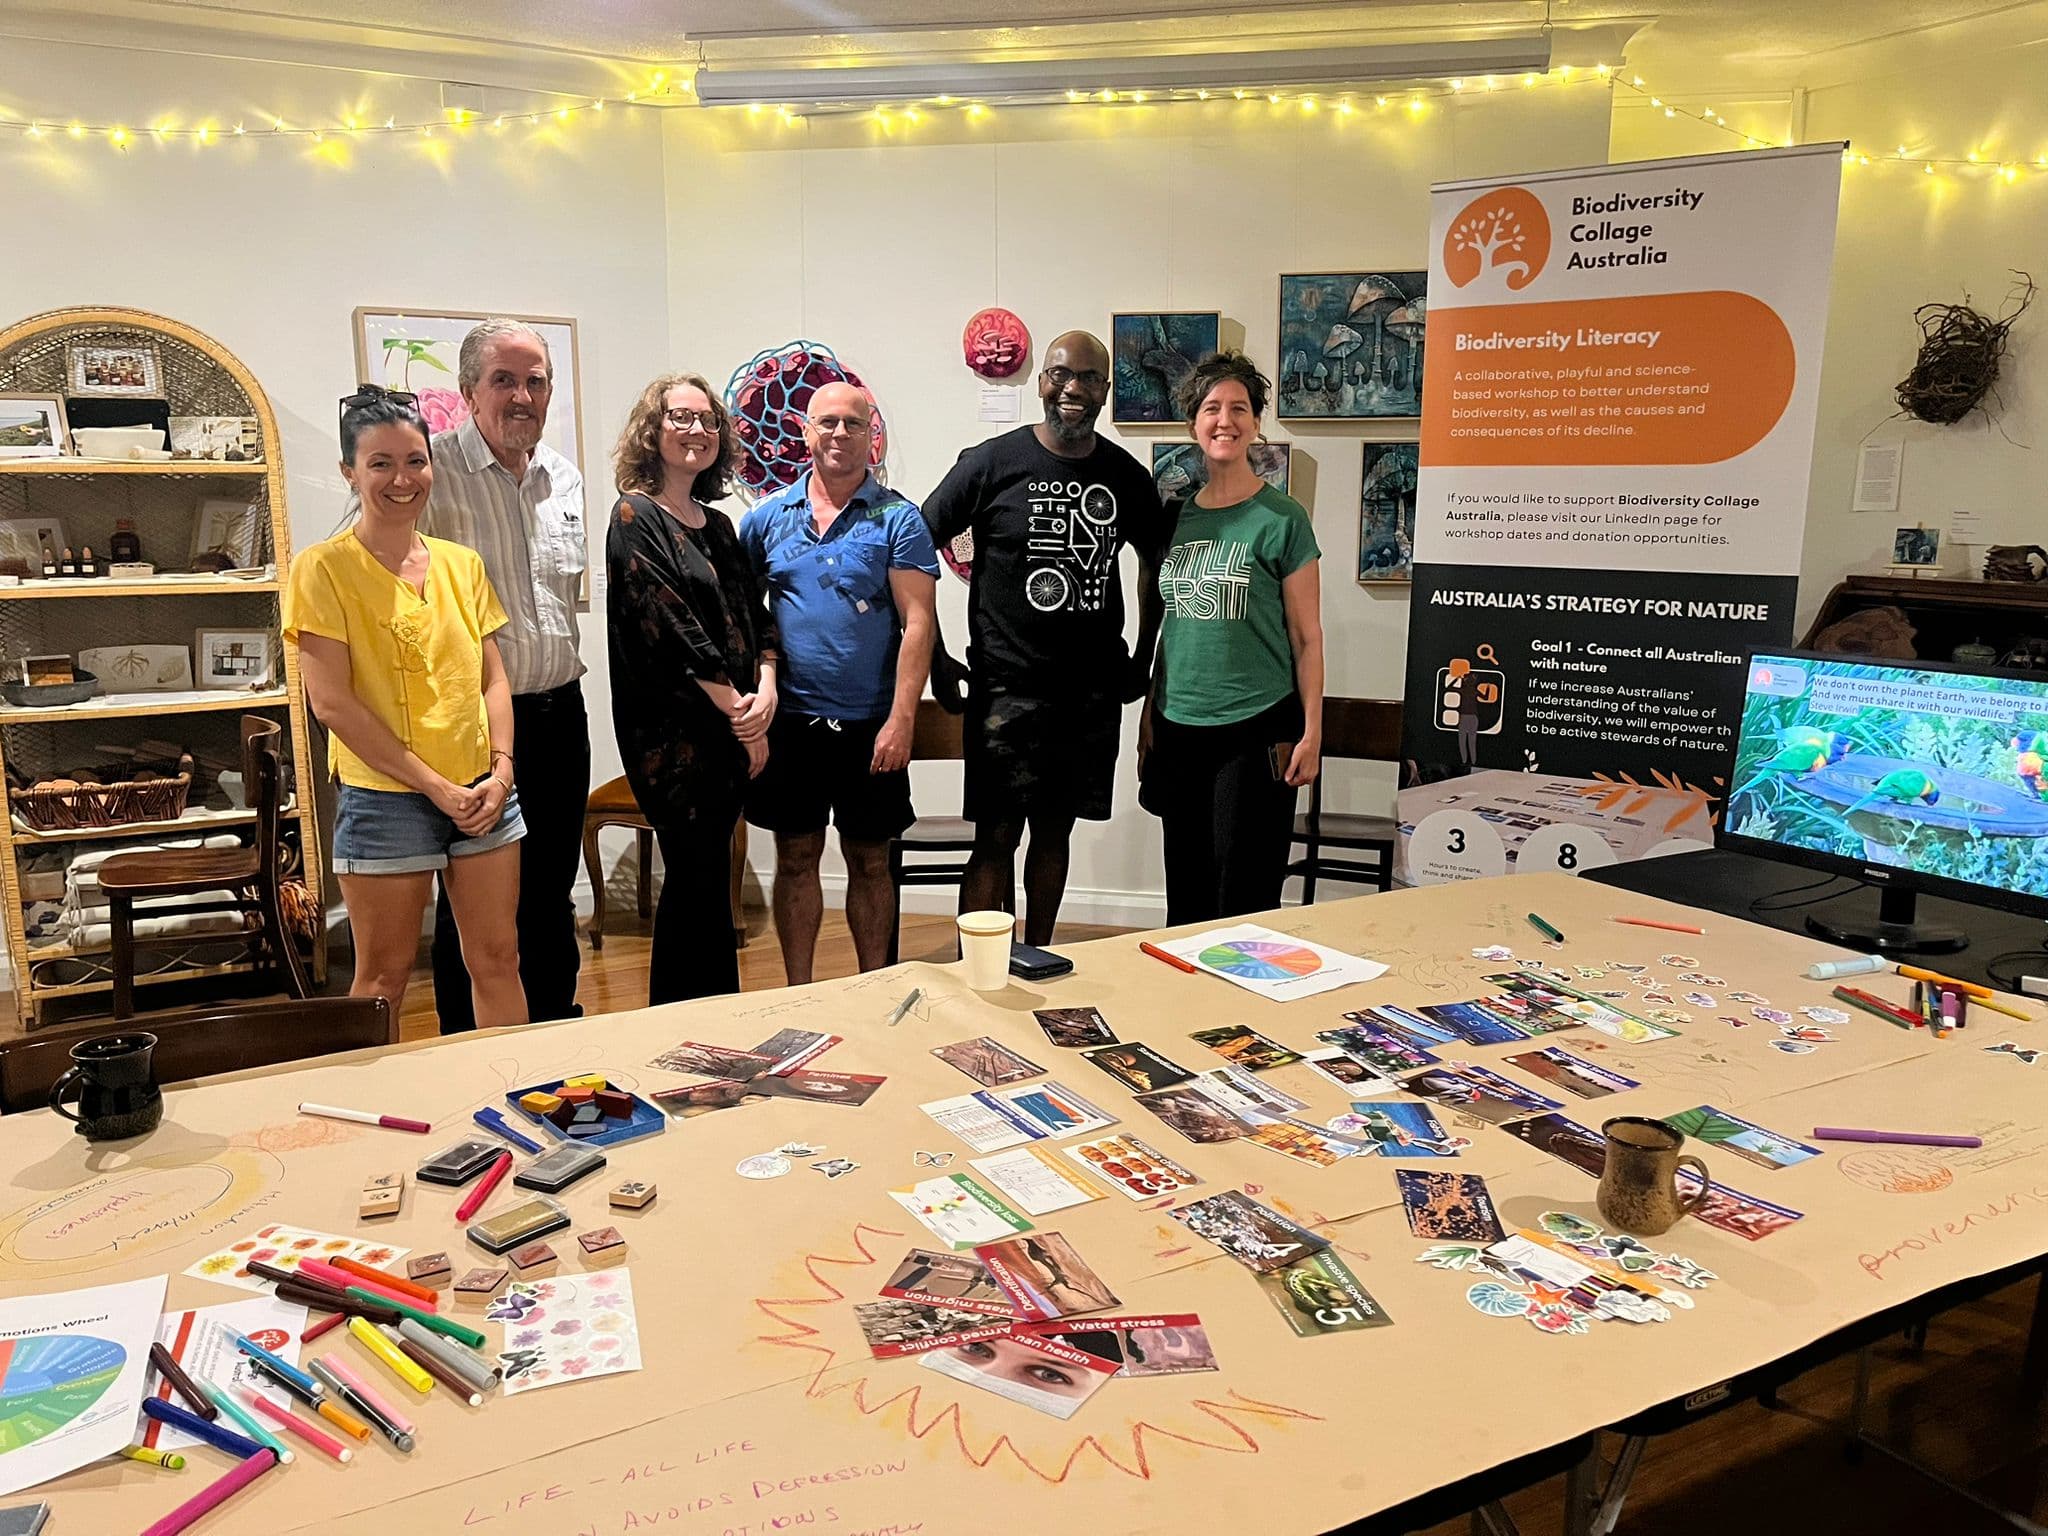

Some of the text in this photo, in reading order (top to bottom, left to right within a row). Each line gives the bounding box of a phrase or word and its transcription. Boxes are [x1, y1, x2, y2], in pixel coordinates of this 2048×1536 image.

[1572, 188, 1704, 216] Biodiversity
[1570, 222, 1653, 244] Collage
[1567, 248, 1668, 270] Australia
[1455, 328, 1660, 352] Biodiversity Literacy
[1454, 363, 1697, 381] A collaborative, playful and science-
[1453, 383, 1709, 400] based workshop to better understand
[1452, 403, 1705, 420] biodiversity, as well as the causes and
[1450, 425, 1543, 439] consequences
[1547, 424, 1562, 436] of
[1564, 424, 1580, 436] its
[1447, 493, 1760, 509] If you would like to support Biodiversity Collage
[1446, 511, 1722, 528] Australia, please visit our LinkedIn page for
[1445, 528, 1730, 546] workshop dates and donation opportunities.
[1545, 593, 1640, 614] STRATEGY
[1644, 598, 1683, 618] FOR
[1687, 601, 1769, 621] NATURE
[1531, 639, 1562, 653] Goal
[1565, 641, 1572, 653] 1
[1587, 643, 1643, 659] Connect
[1645, 645, 1663, 659] all
[1530, 657, 1608, 674] with nature
[1528, 678, 1537, 690] If
[1540, 681, 1558, 692] we
[1561, 680, 1614, 695] increase
[1814, 677, 1828, 688] We
[1857, 684, 1878, 693] own
[1881, 684, 1898, 695] the
[1900, 687, 1934, 700] planet
[1936, 690, 1968, 703] Earth,
[1970, 695, 1987, 705] we
[1989, 696, 2027, 711] belong
[2029, 701, 2042, 711] to
[1527, 693, 1716, 719] understanding of the value of
[1810, 701, 1858, 715] Steve Irwin
[1811, 689, 1831, 700] And
[1832, 692, 1847, 701] we
[1848, 693, 1874, 704] must
[1876, 697, 1904, 708] share
[1906, 699, 1915, 709] it
[1917, 700, 1941, 712] with
[1943, 704, 1962, 713] our
[1526, 707, 1732, 737] biodiversity, we will empower th
[1526, 723, 1729, 752] to be active stewards of nature.
[1447, 828, 1466, 853] 3
[1557, 843, 1577, 869] 8
[1001, 1208, 1020, 1225] loss
[1253, 1205, 1297, 1233] Pollution
[1318, 1252, 1377, 1316] Invasive species
[903, 1289, 1015, 1318] Mass migration
[0, 1313, 109, 1339] motions Wheel
[1068, 1317, 1166, 1331] Water stress
[1314, 1306, 1364, 1326] 5
[898, 1325, 1012, 1353] Armed conflict
[1043, 1343, 1091, 1365] health
[621, 1462, 680, 1485] ALL
[695, 1440, 759, 1465] LIFE
[624, 1492, 735, 1531] AVOIDS
